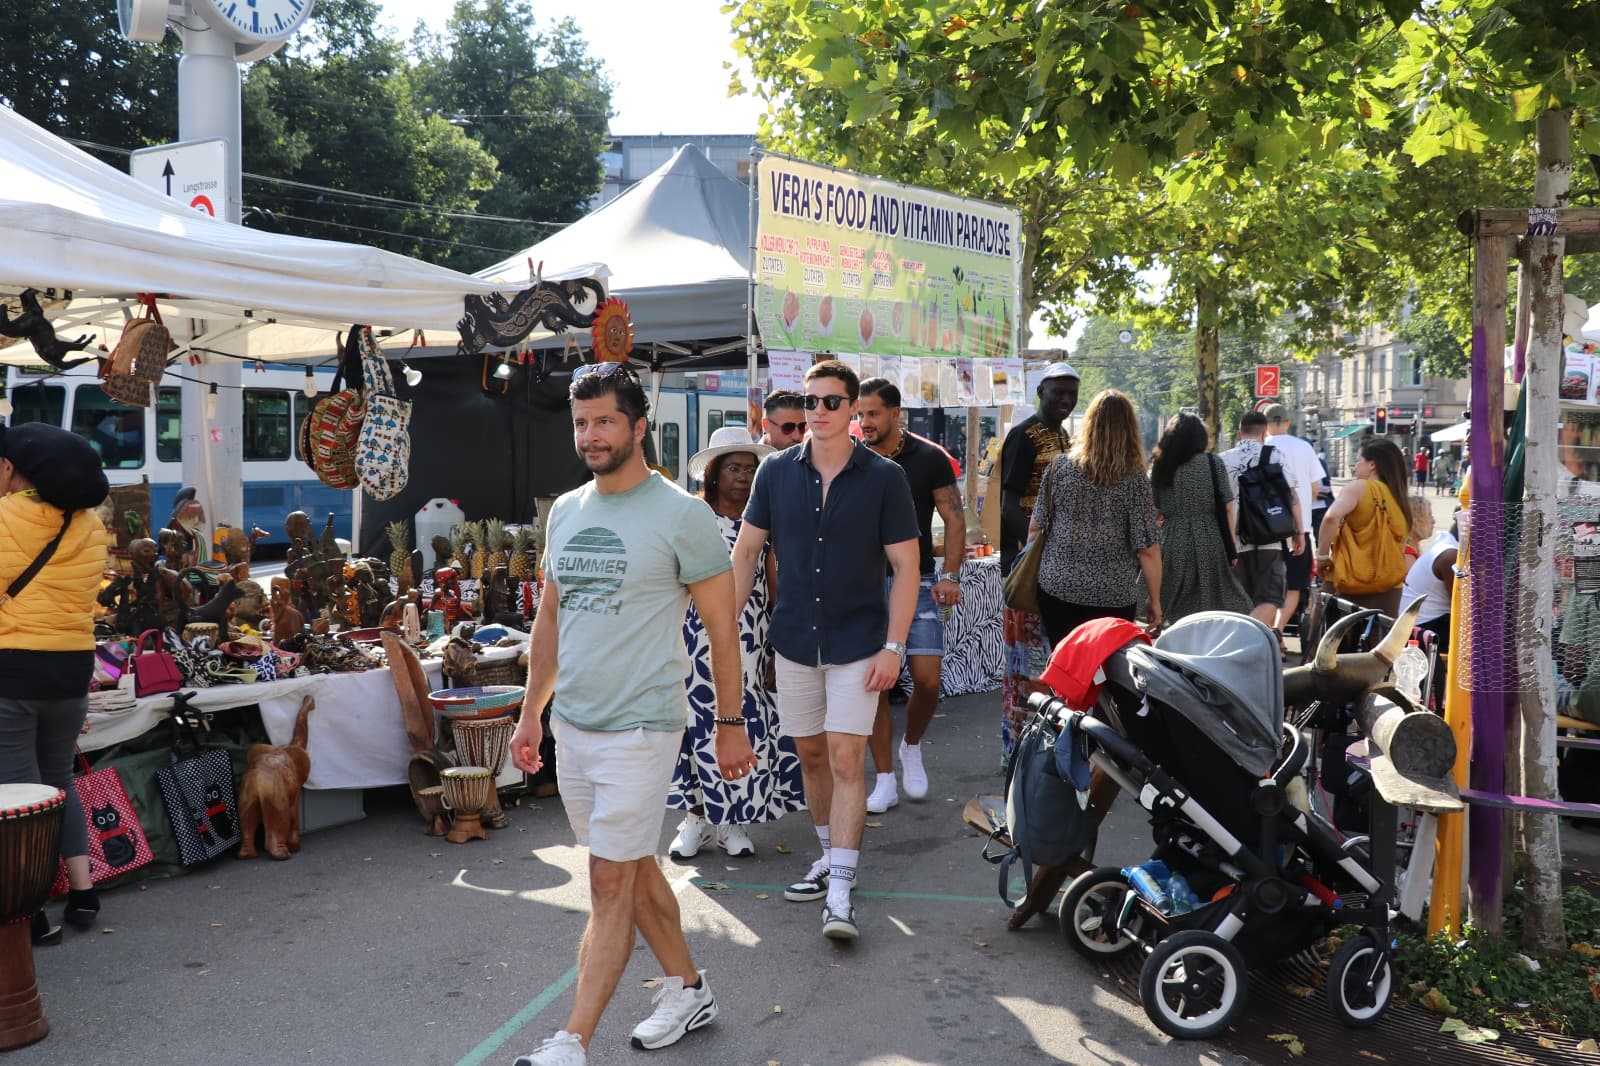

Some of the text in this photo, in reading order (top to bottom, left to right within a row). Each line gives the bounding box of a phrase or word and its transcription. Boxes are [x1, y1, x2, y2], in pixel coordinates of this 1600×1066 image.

[183, 180, 218, 194] Langstrasse
[771, 171, 1011, 257] VERA'S FOOD AND VITAMIN PARADISE
[557, 556, 628, 575] SUMMER
